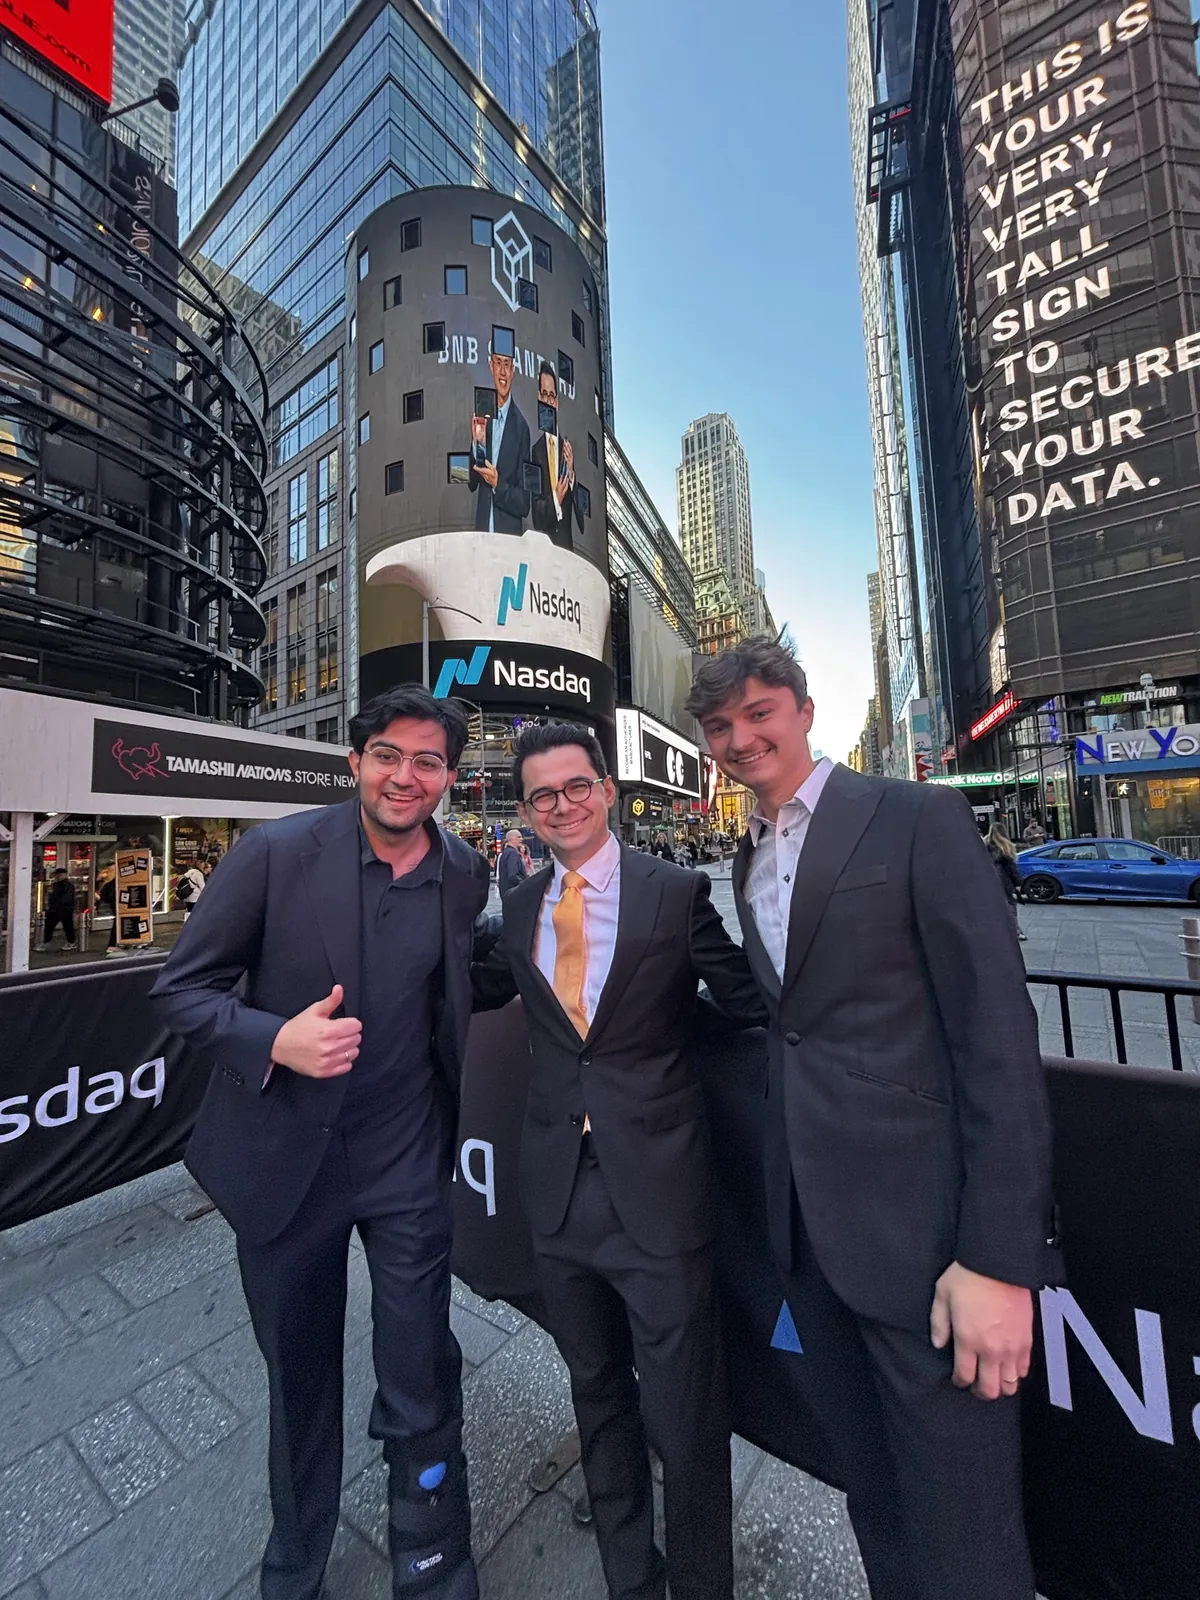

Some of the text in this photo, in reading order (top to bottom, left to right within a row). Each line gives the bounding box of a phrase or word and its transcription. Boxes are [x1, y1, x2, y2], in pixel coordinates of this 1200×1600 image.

[971, 1, 1150, 125] THIS IS
[974, 74, 1108, 168] YOUR
[978, 120, 1112, 210] VERY,
[982, 167, 1108, 253] VERY
[986, 225, 1109, 296] TALL
[992, 267, 1111, 342] SIGN
[438, 335, 478, 364] BNB
[994, 340, 1059, 386] TO
[1000, 332, 1200, 432] SECURE
[1001, 408, 1145, 477] YOUR
[1007, 461, 1161, 526] DATA.
[529, 581, 581, 634] Nasdaq
[493, 660, 591, 703] Nasdaq
[166, 756, 234, 777] TAMASHII
[295, 771, 331, 788] STORE
[333, 775, 356, 789] NEW
[967, 774, 993, 784] Now
[1075, 727, 1199, 765] NEW YO
[0, 1056, 166, 1144] sdaq
[452, 1138, 497, 1217] q
